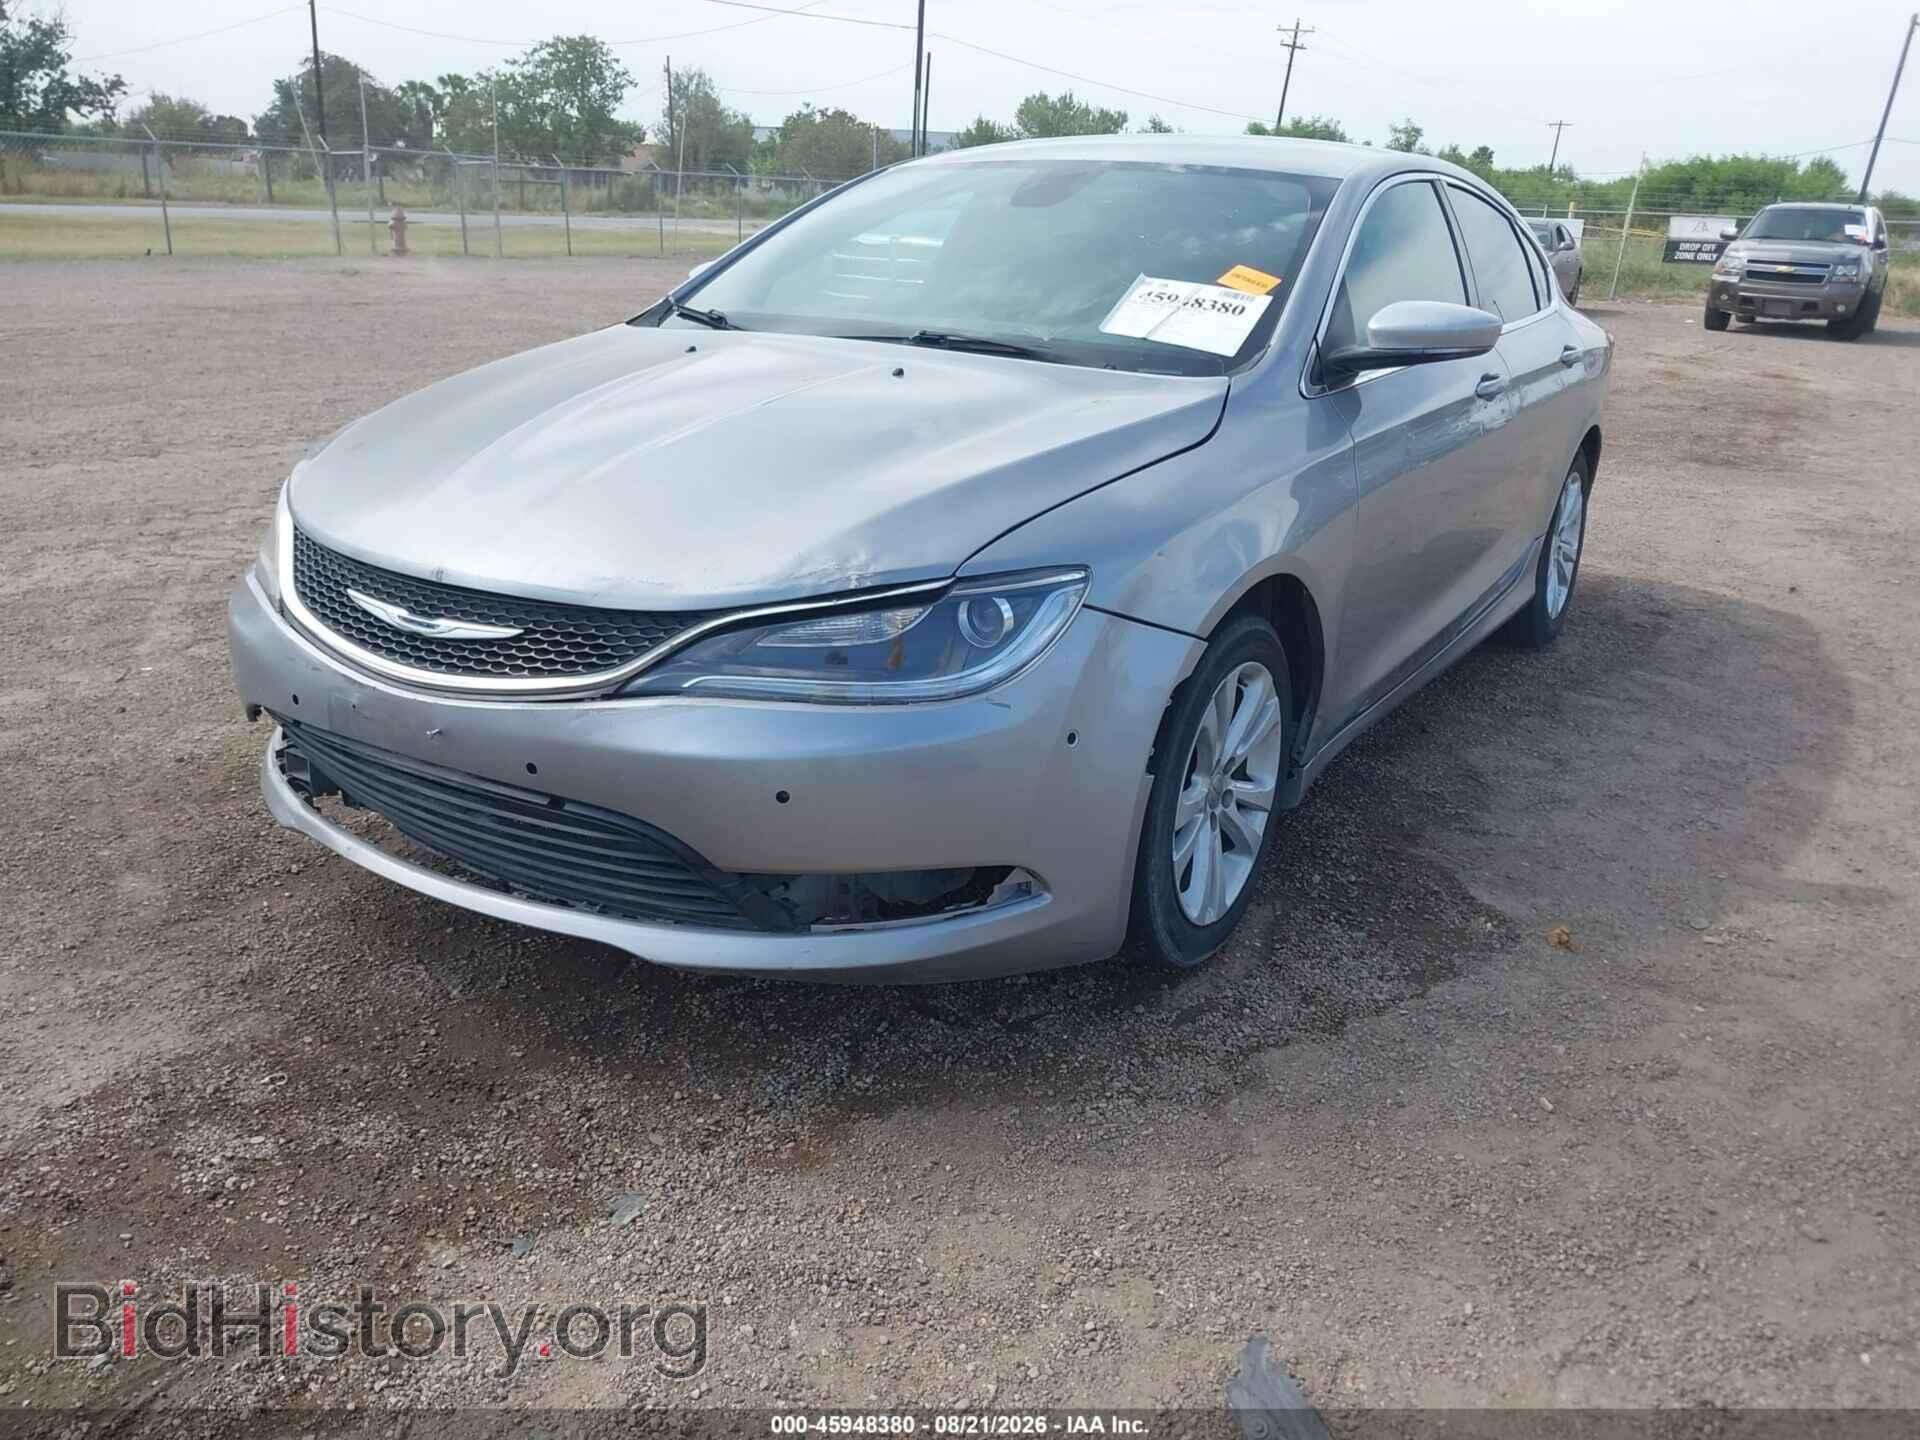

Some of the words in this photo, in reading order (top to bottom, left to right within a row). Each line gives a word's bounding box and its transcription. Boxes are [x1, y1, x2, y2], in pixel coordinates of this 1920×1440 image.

[1679, 242, 1701, 251] DROP
[1702, 242, 1716, 252] OFF
[1674, 251, 1697, 260] ZONE
[1697, 252, 1719, 261] ONLY
